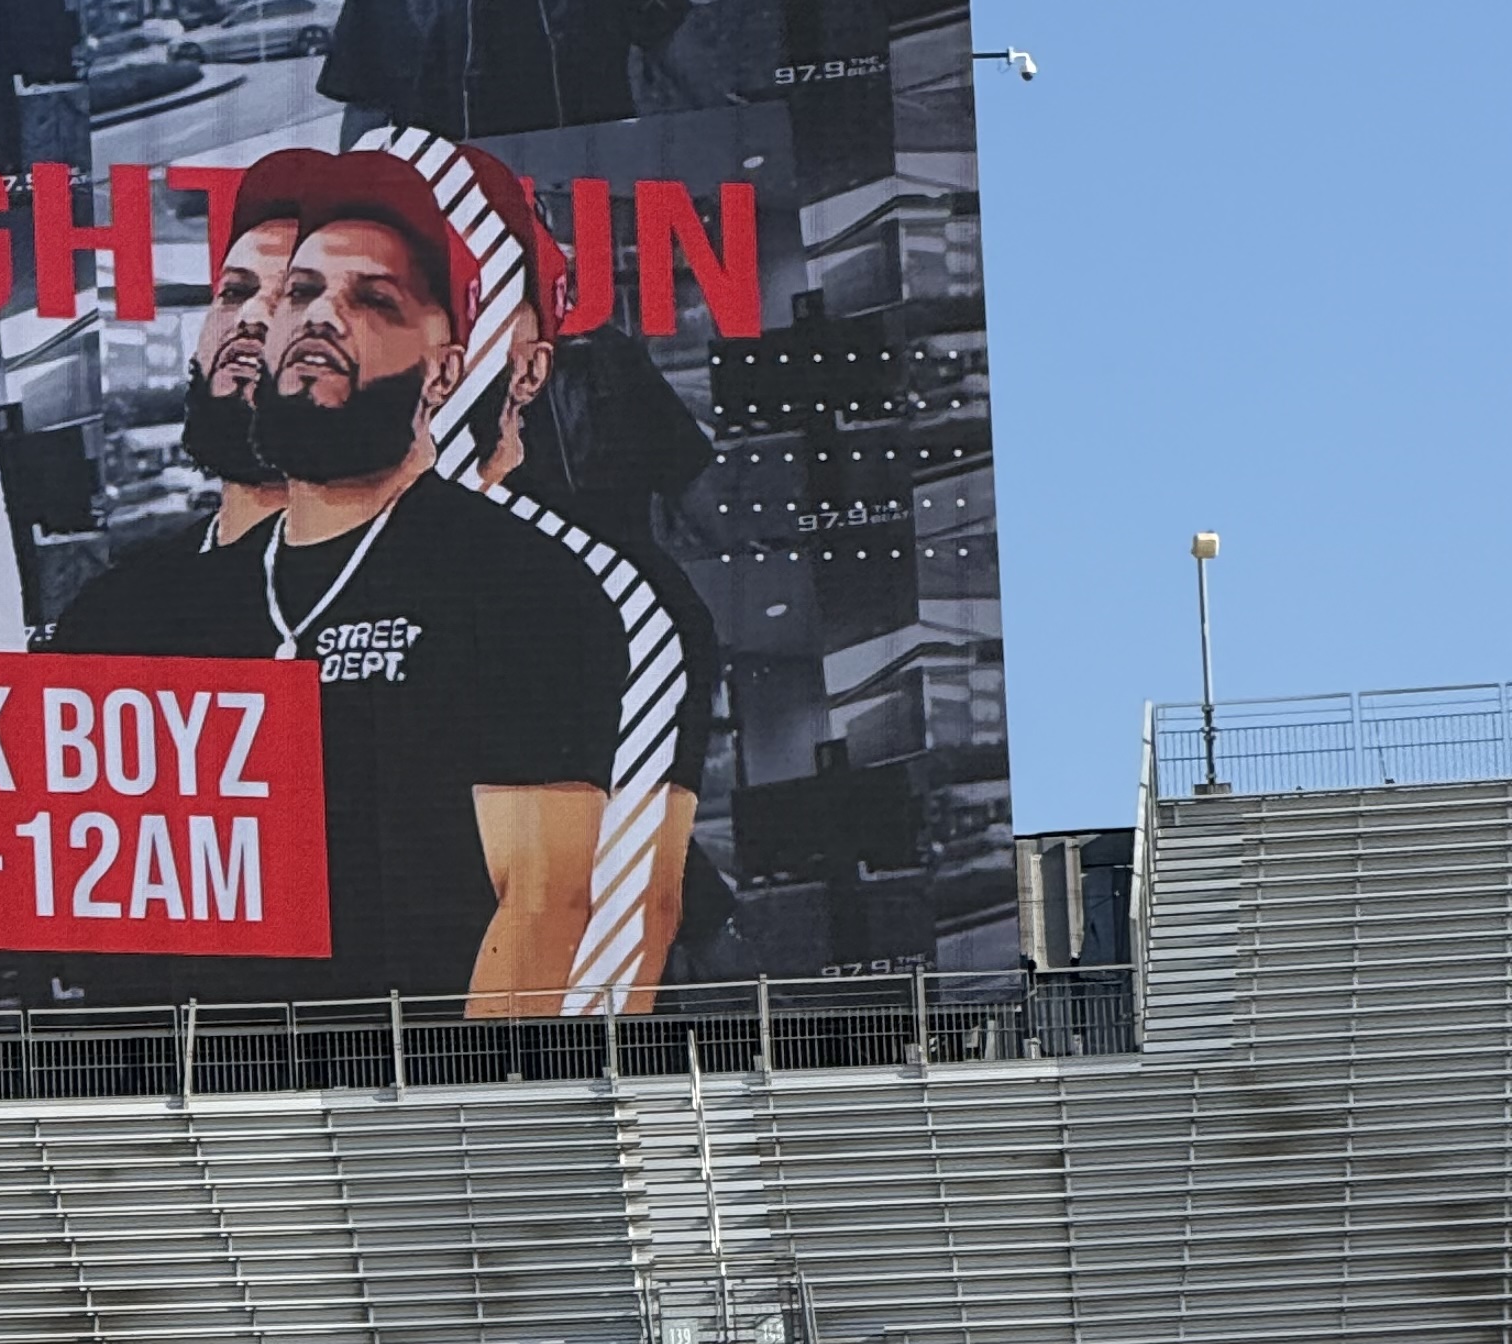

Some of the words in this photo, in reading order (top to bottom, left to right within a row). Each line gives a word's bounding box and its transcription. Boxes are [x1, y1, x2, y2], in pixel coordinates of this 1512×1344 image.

[775, 60, 845, 84] 97.9
[798, 508, 867, 532] 97.9
[320, 651, 406, 683] DEPT.
[43, 687, 270, 799] BOYZ
